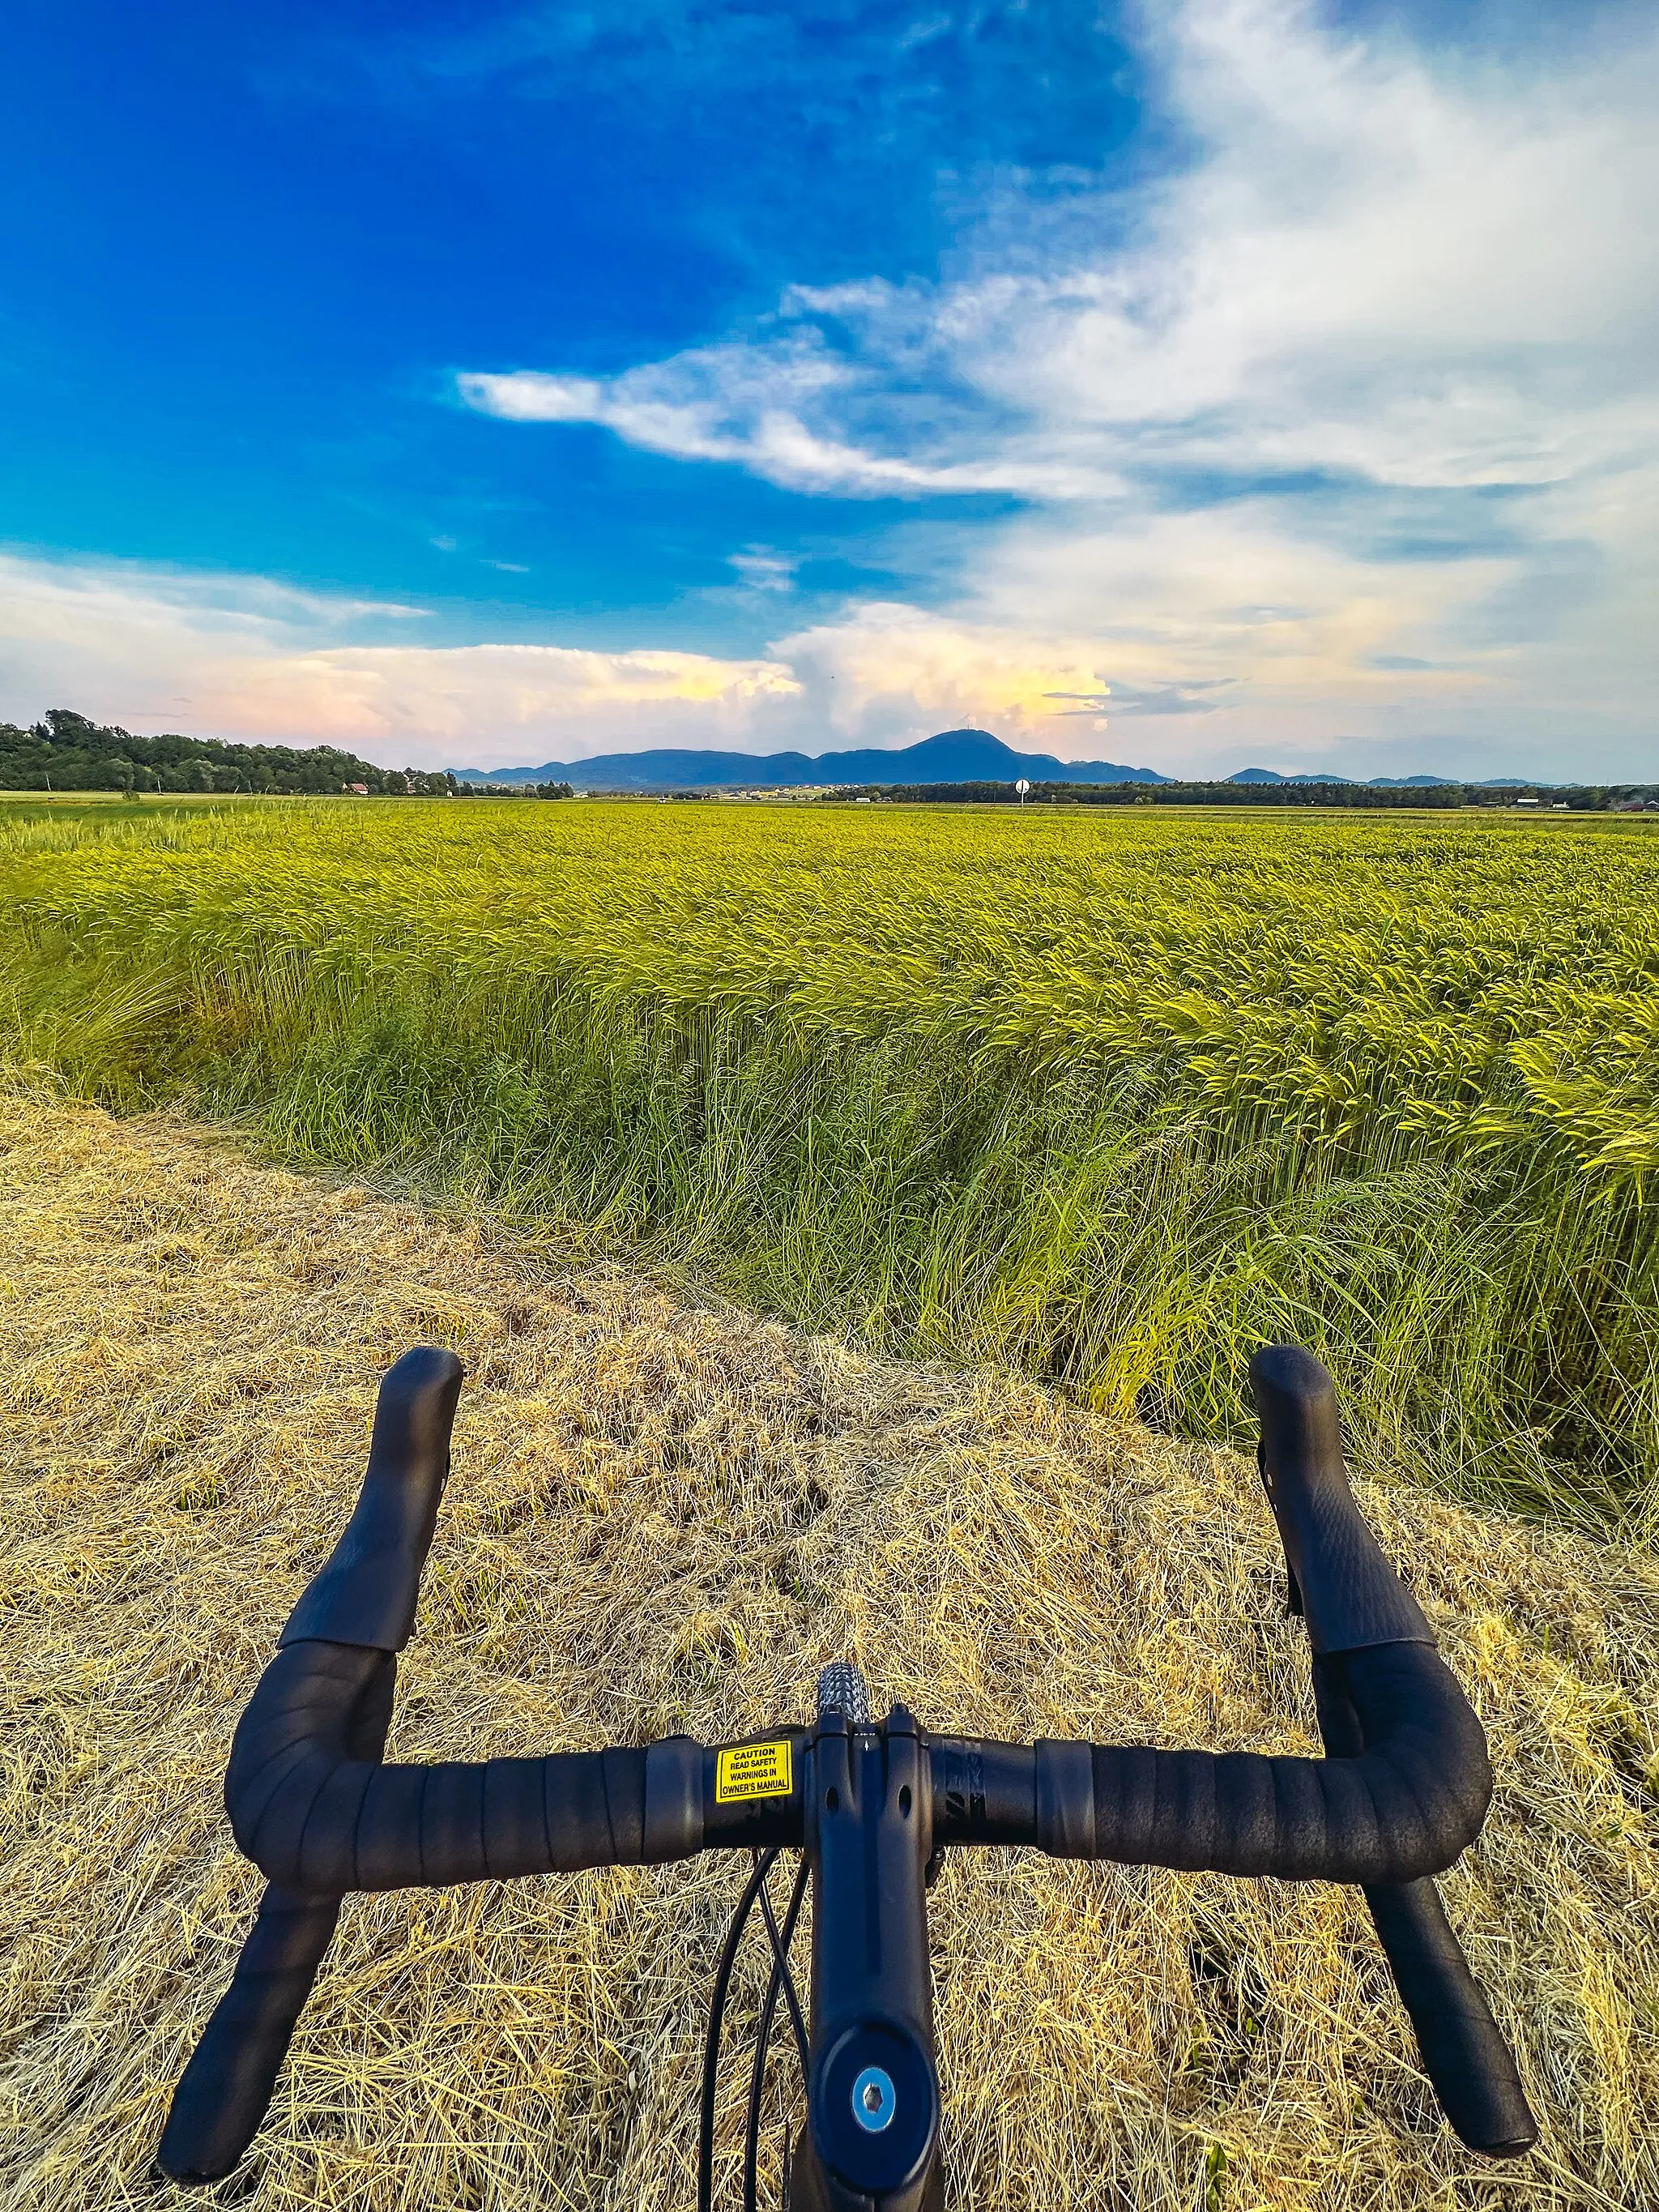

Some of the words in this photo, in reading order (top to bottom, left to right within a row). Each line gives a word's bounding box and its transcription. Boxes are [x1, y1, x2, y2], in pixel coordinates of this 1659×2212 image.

[734, 1748, 775, 1760] CAUTION
[730, 1761, 749, 1770] READ
[750, 1757, 777, 1767] SAFETY
[730, 1770, 768, 1781] WARNINGS
[770, 1768, 777, 1776] IN
[723, 1783, 755, 1795] OWNER'S
[757, 1779, 787, 1790] MANUAL
